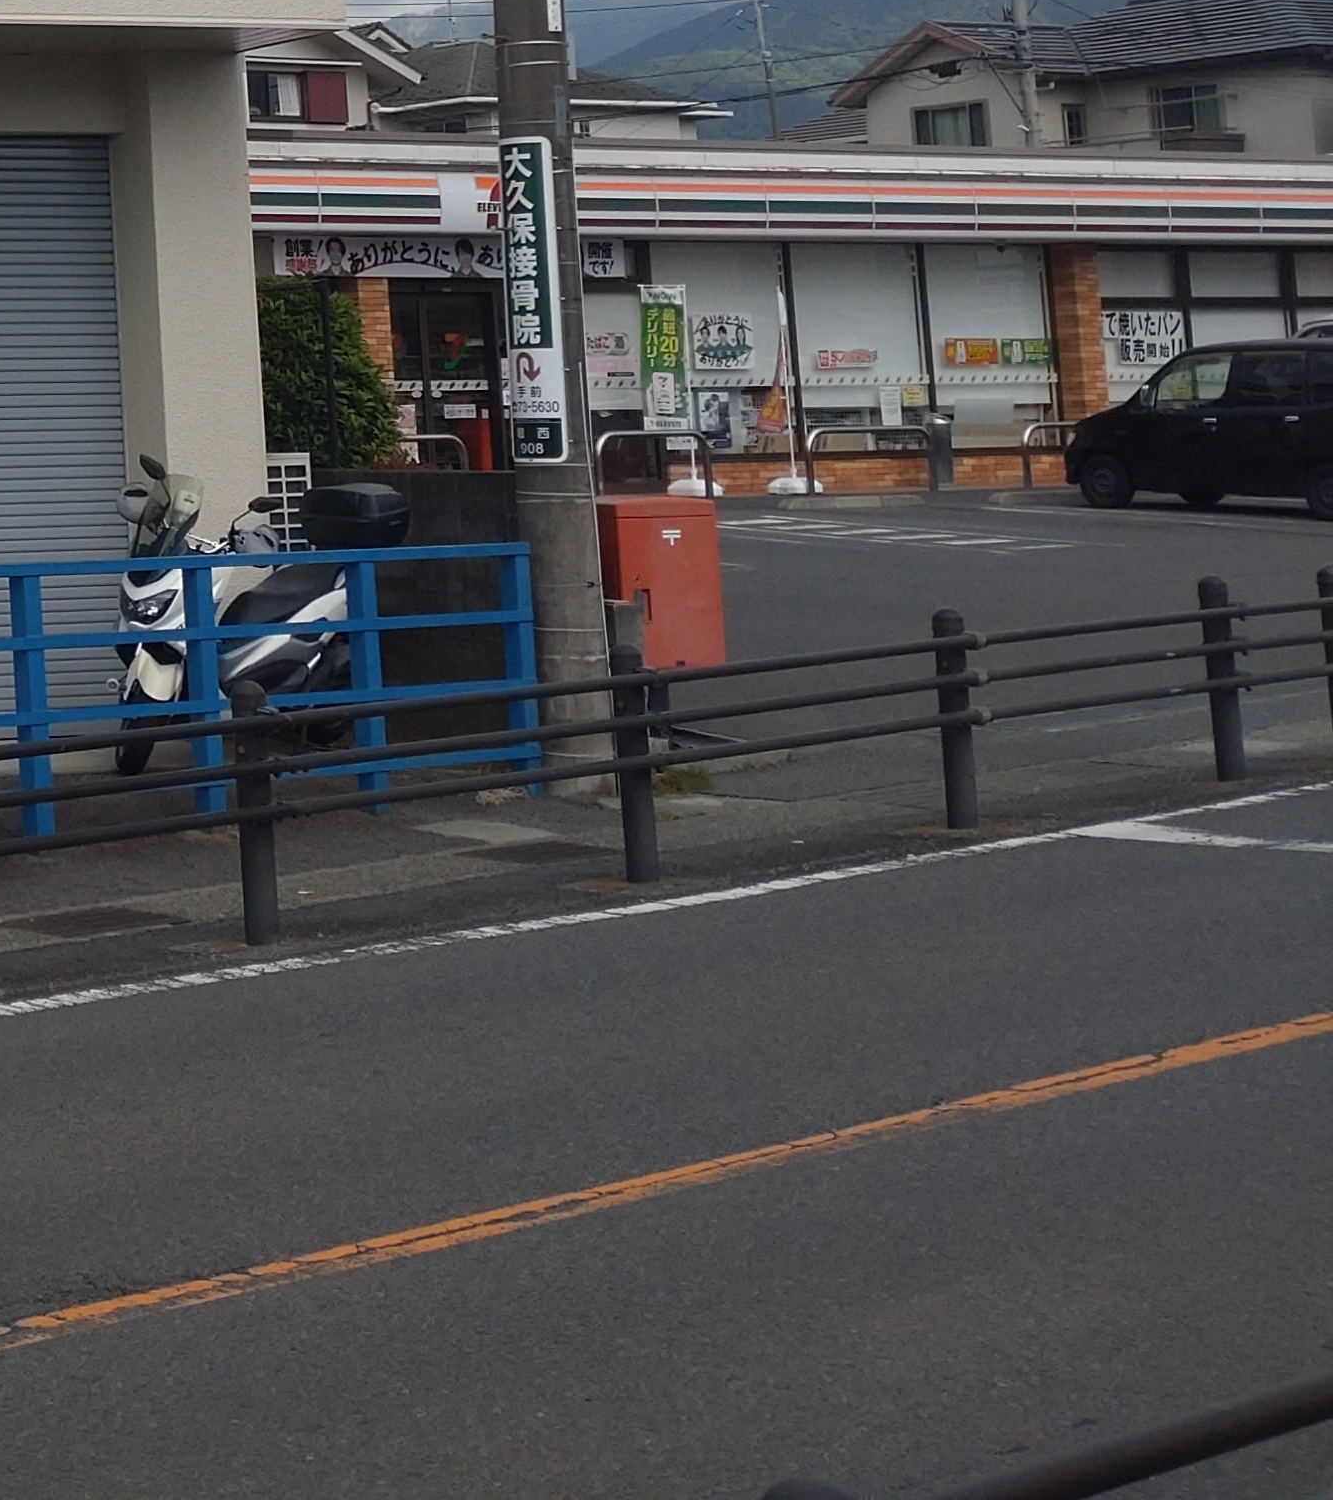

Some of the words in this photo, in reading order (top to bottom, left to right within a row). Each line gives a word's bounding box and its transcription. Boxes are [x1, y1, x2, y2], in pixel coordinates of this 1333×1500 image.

[504, 146, 541, 346] 大久保接骨院
[588, 242, 613, 259] 開催
[1101, 312, 1181, 337] で焼いたパン
[517, 386, 542, 398] 手前
[520, 443, 544, 454] 908
